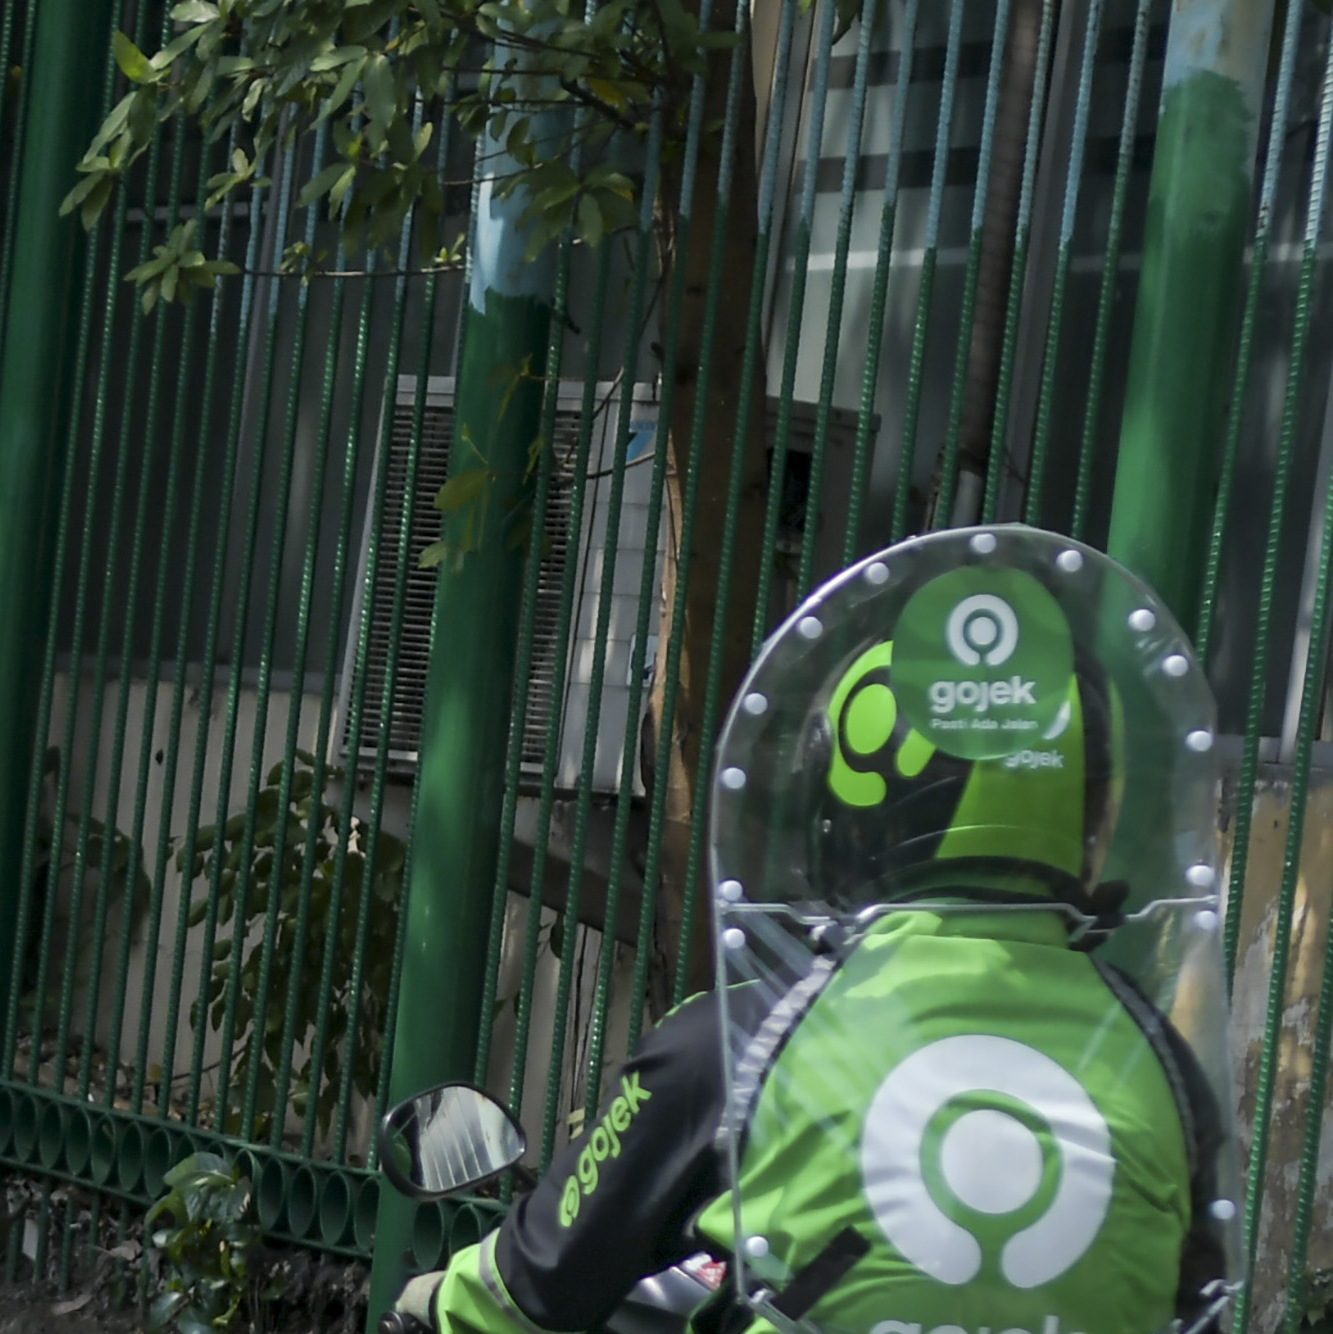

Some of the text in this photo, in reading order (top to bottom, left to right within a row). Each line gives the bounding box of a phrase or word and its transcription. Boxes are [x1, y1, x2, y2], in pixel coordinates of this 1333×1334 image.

[930, 676, 1037, 713] gojek
[932, 718, 1039, 729] Pasti Ada Jalan
[579, 1070, 653, 1195] gojek
